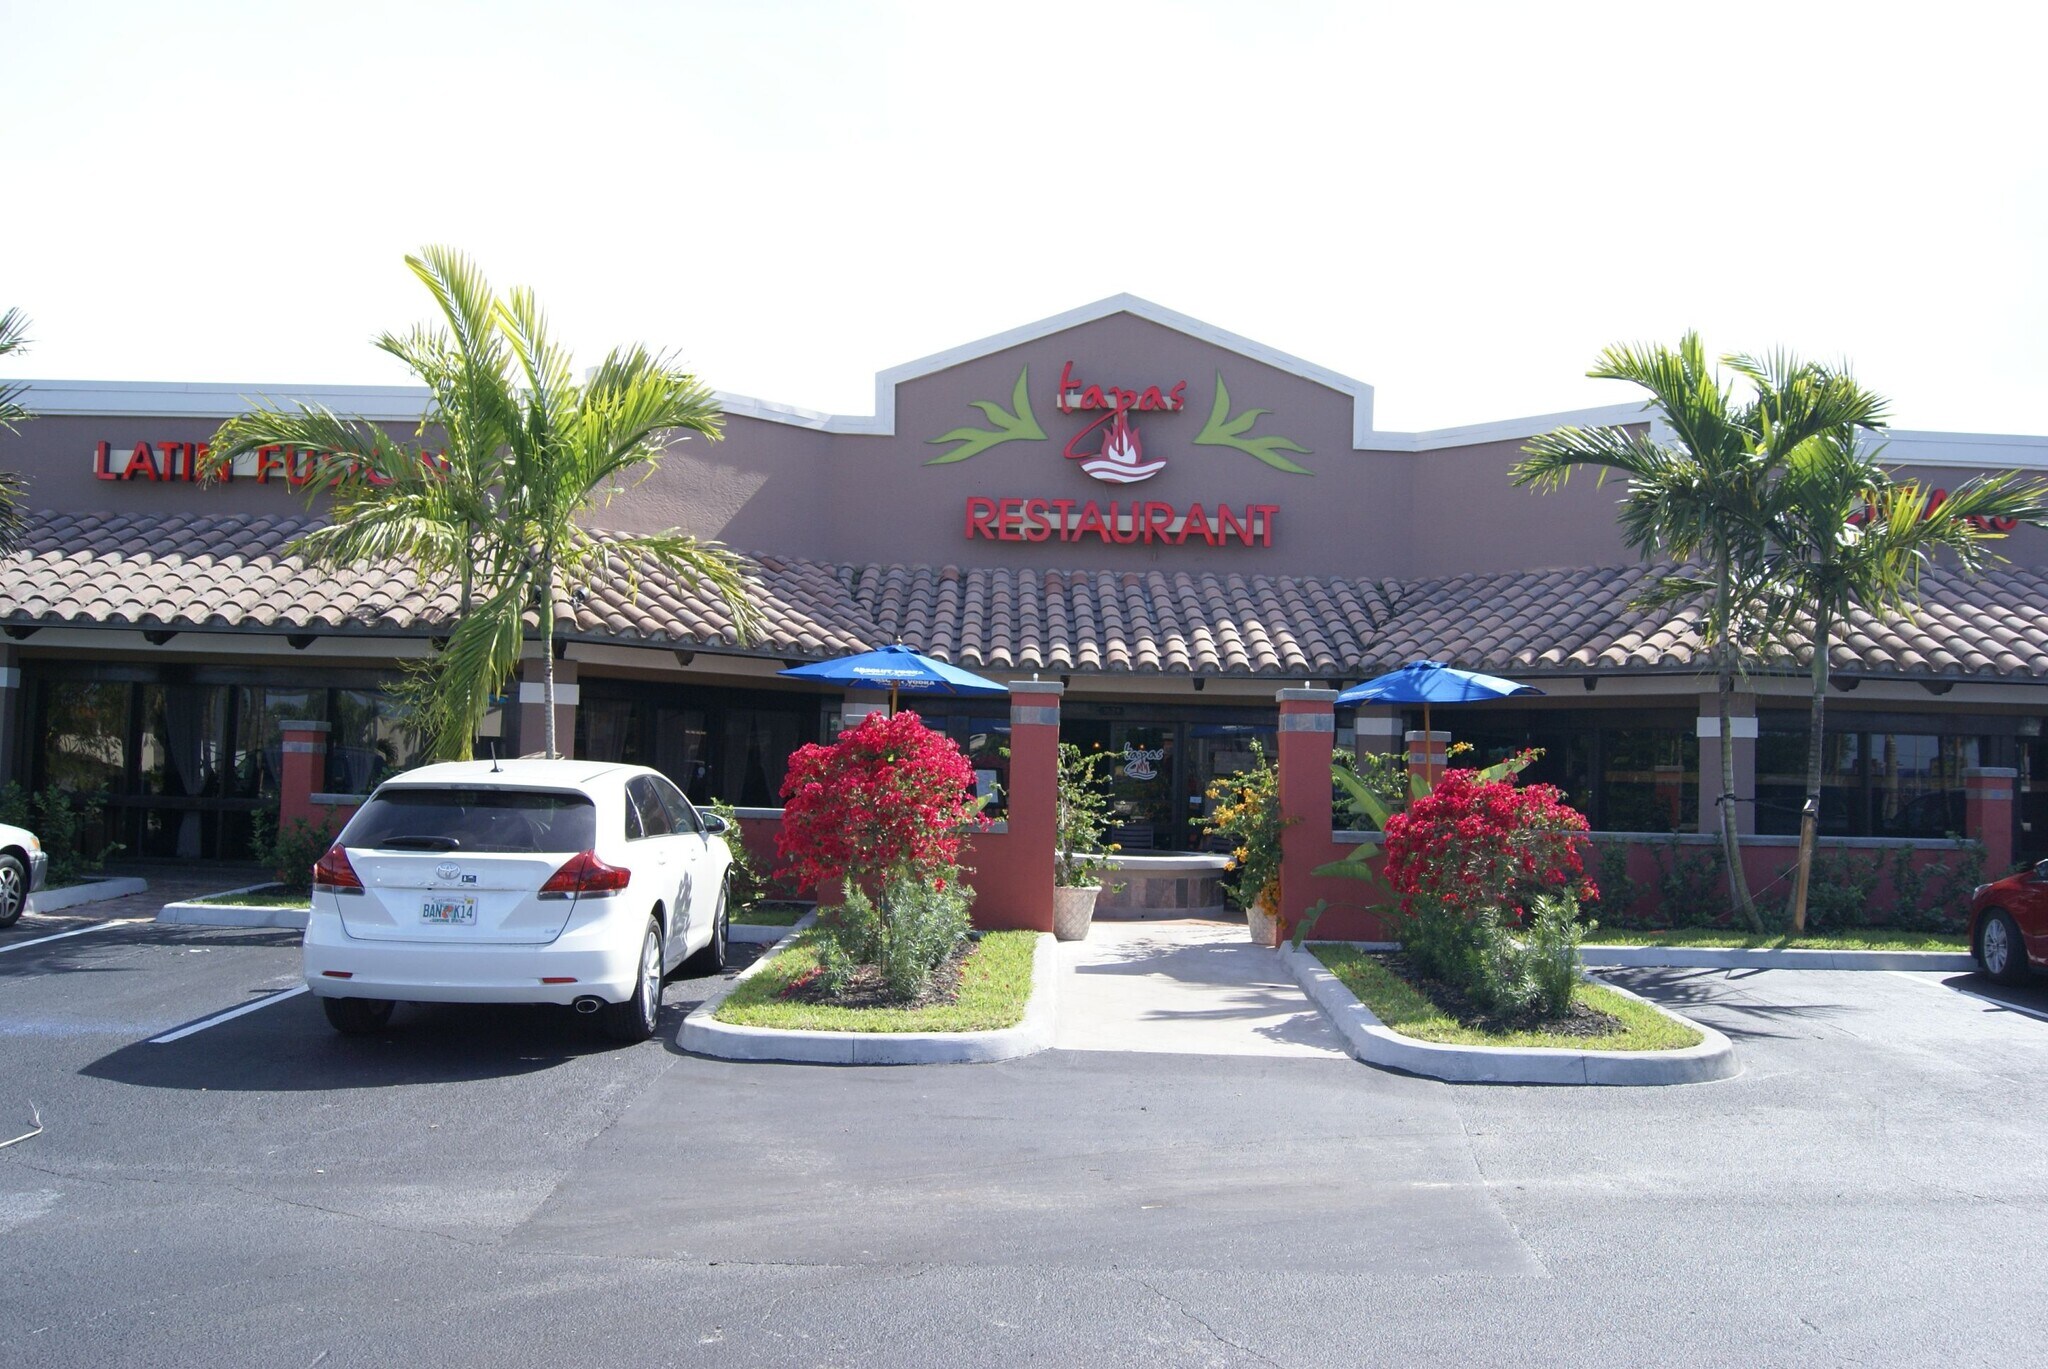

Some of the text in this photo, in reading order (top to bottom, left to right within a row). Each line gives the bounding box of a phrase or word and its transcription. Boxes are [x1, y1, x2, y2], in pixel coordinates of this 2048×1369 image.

[1058, 361, 1187, 457] tapas
[965, 496, 1280, 548] RESTAURANT
[423, 904, 473, 918] BAN K14
